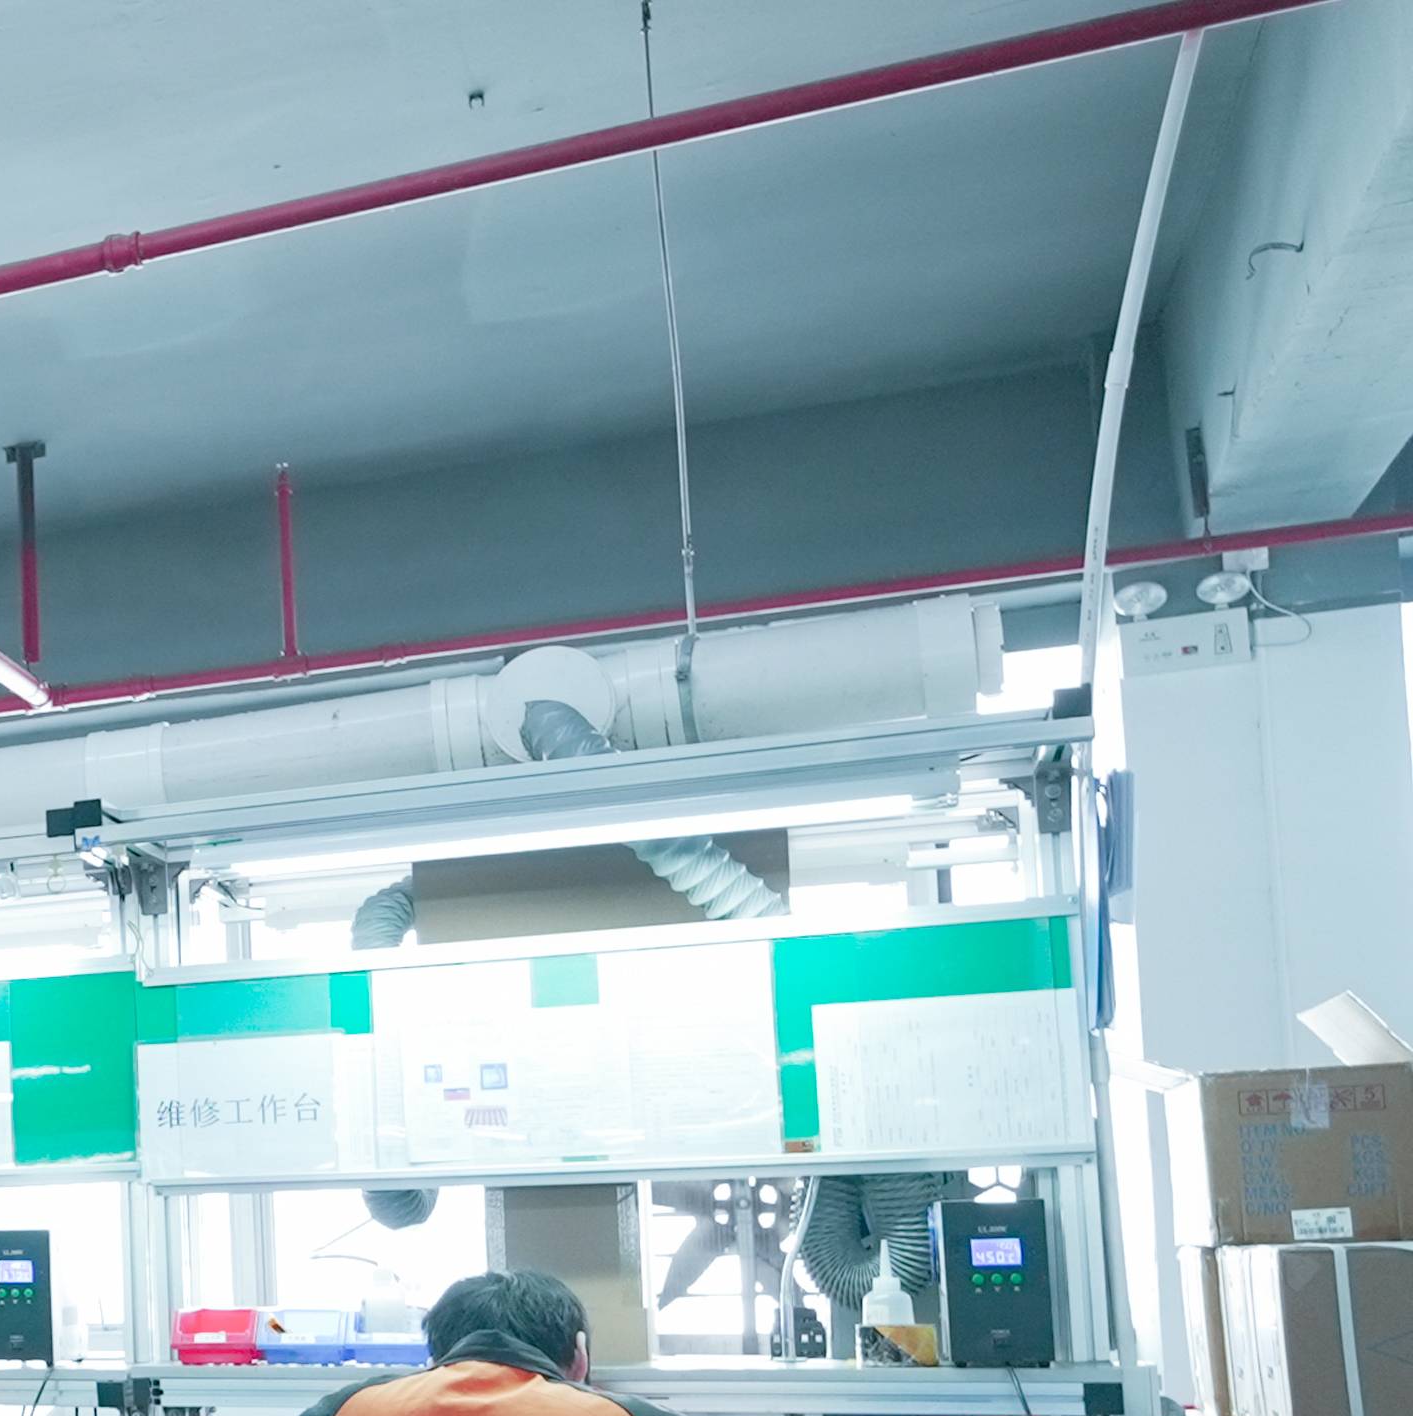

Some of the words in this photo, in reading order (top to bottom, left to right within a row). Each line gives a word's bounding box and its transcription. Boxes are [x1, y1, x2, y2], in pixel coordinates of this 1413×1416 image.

[157, 1092, 321, 1129] 维修工作台
[1239, 1124, 1277, 1138] ITEM
